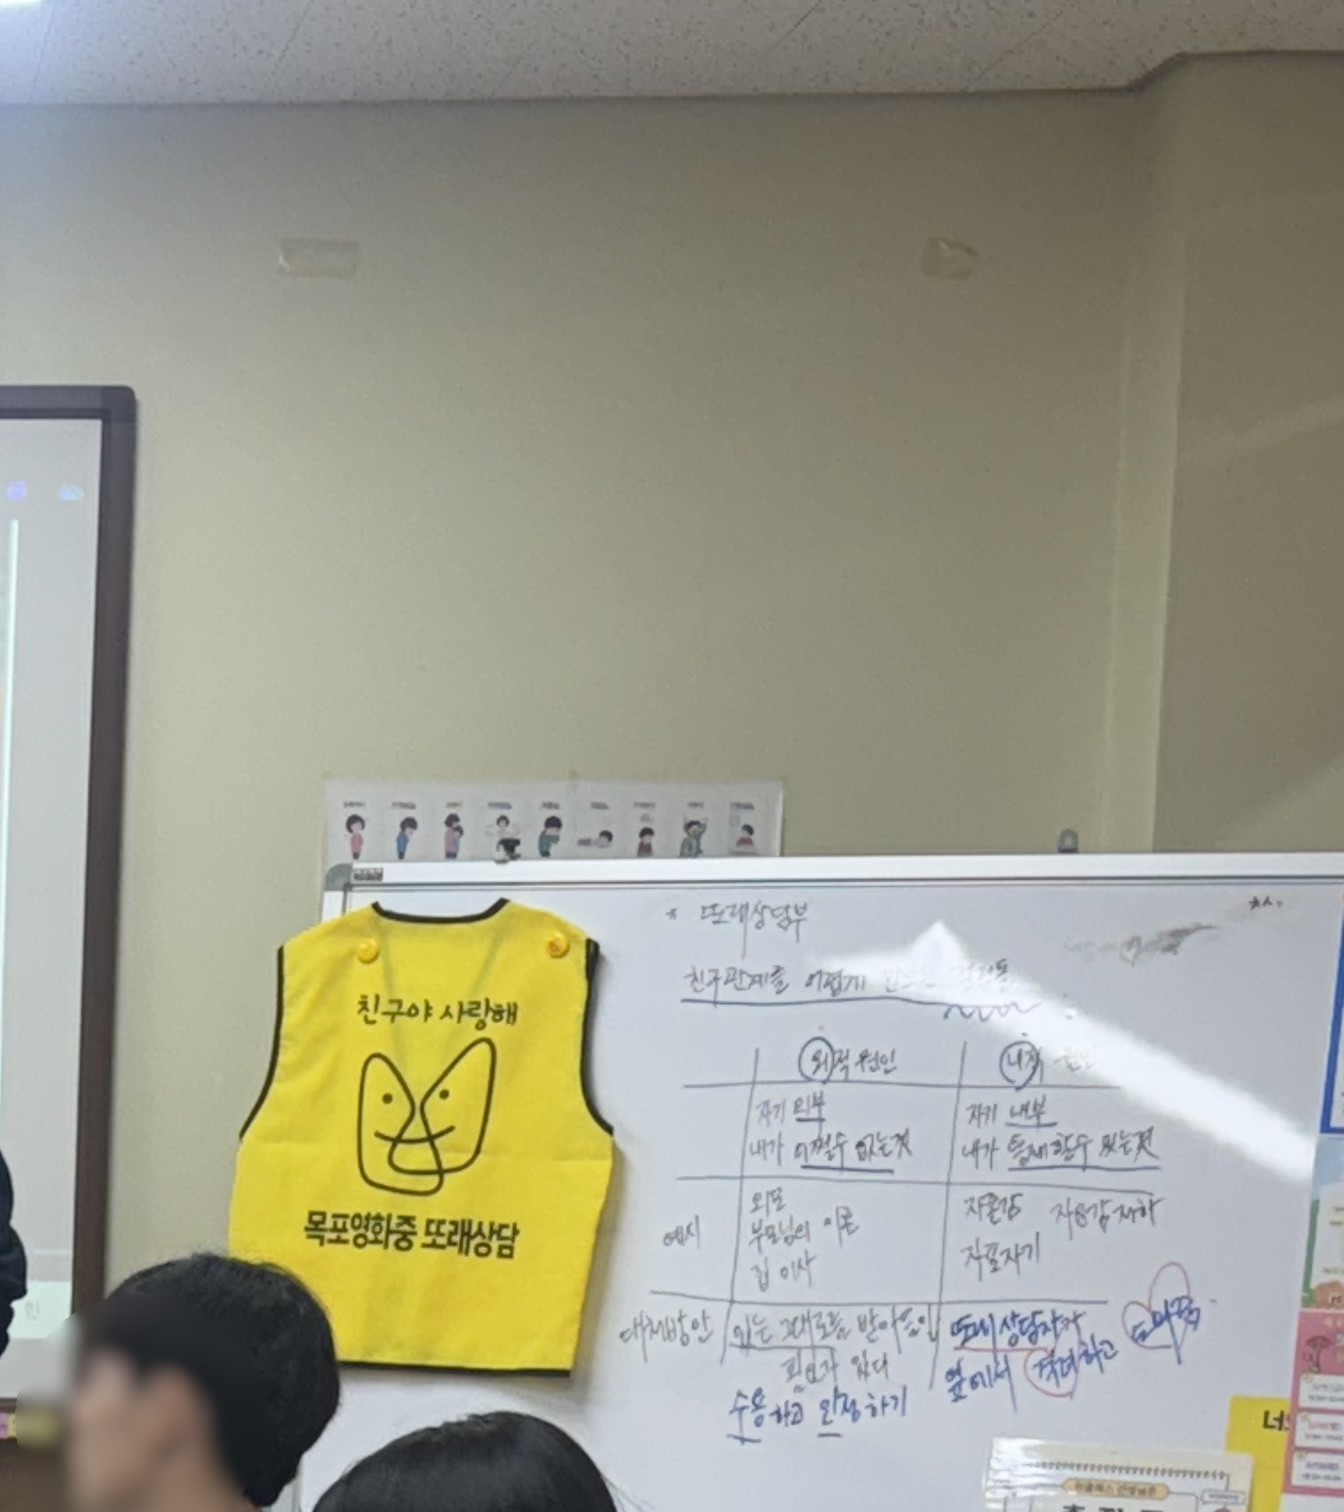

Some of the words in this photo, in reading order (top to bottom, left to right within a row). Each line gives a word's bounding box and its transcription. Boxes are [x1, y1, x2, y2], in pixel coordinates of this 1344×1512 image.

[357, 993, 434, 1026] 친구야
[439, 995, 519, 1032] 사랑해
[304, 1209, 418, 1252] 목포영화중
[421, 1217, 521, 1260] 또래상담
[1261, 1409, 1291, 1433] 너
